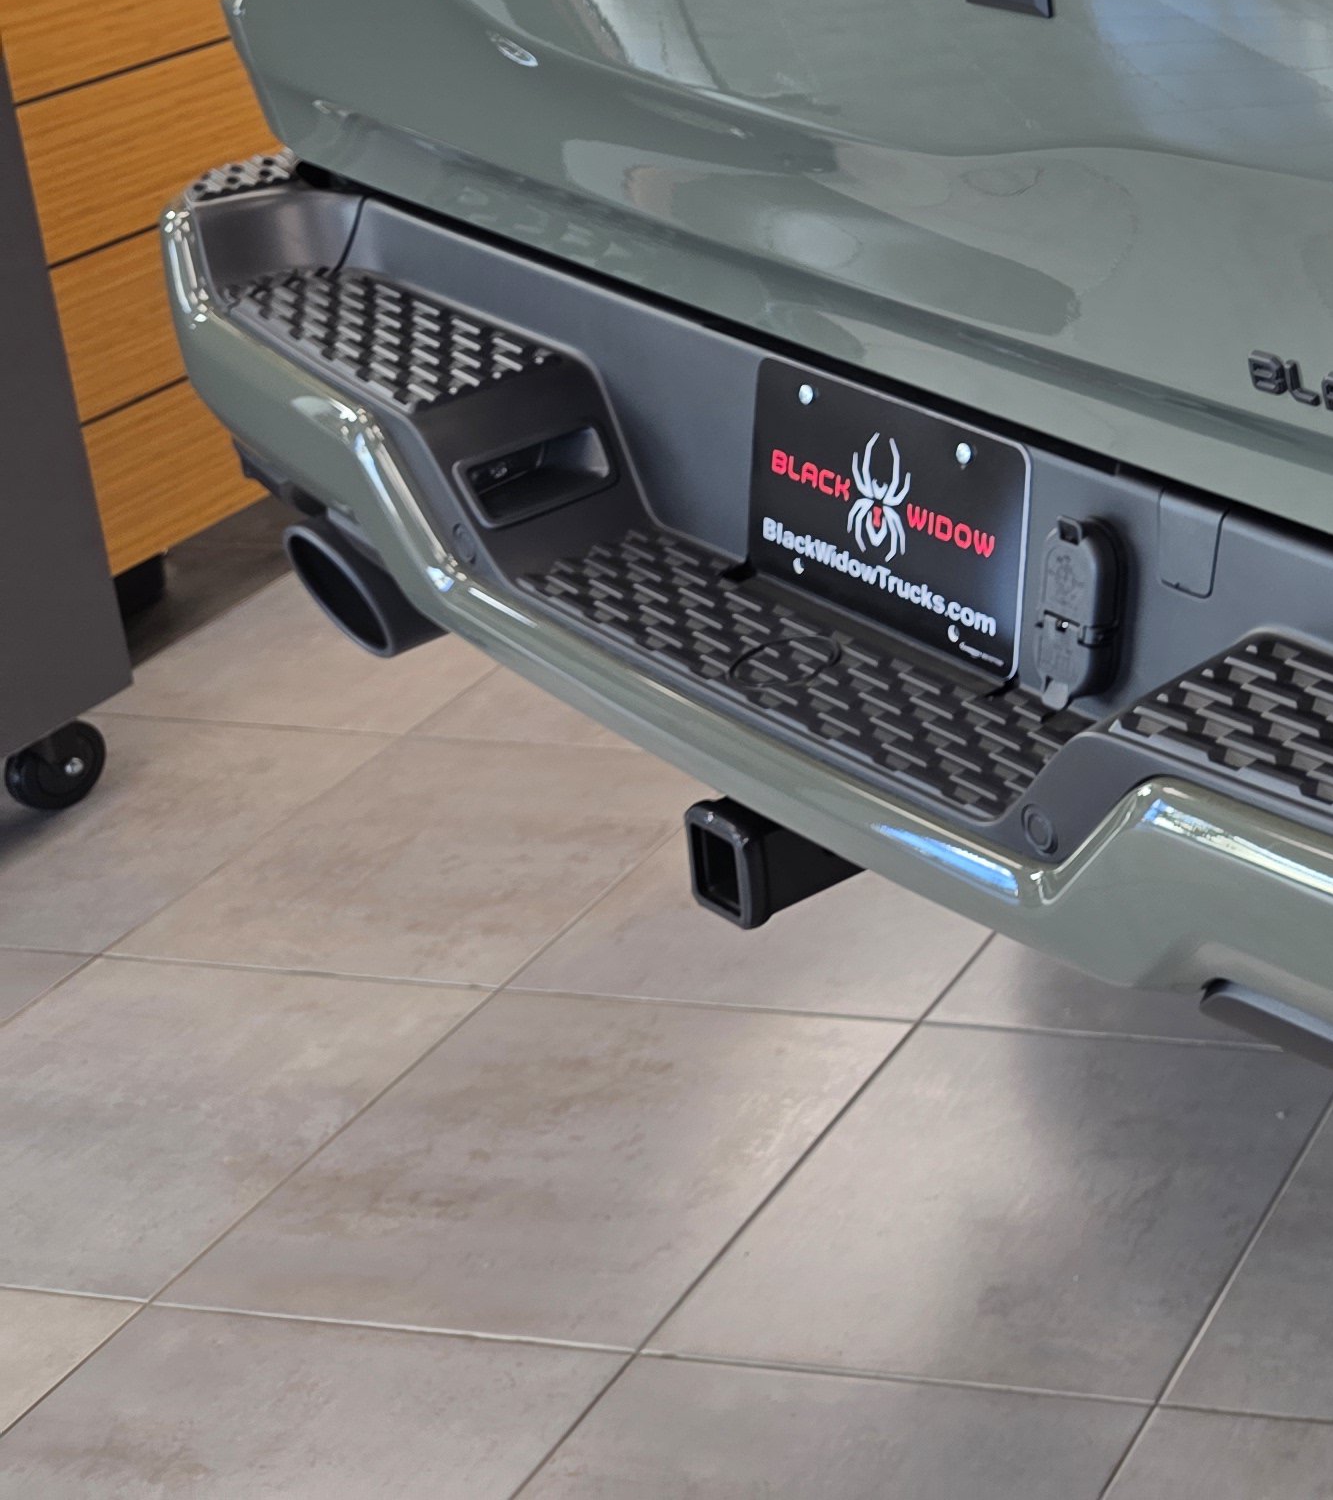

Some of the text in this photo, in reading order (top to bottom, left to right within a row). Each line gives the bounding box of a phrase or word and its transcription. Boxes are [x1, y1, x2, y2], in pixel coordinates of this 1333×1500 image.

[771, 448, 996, 559] BLACK WIDOW
[762, 516, 997, 637] BlackWidowTrucks.com
